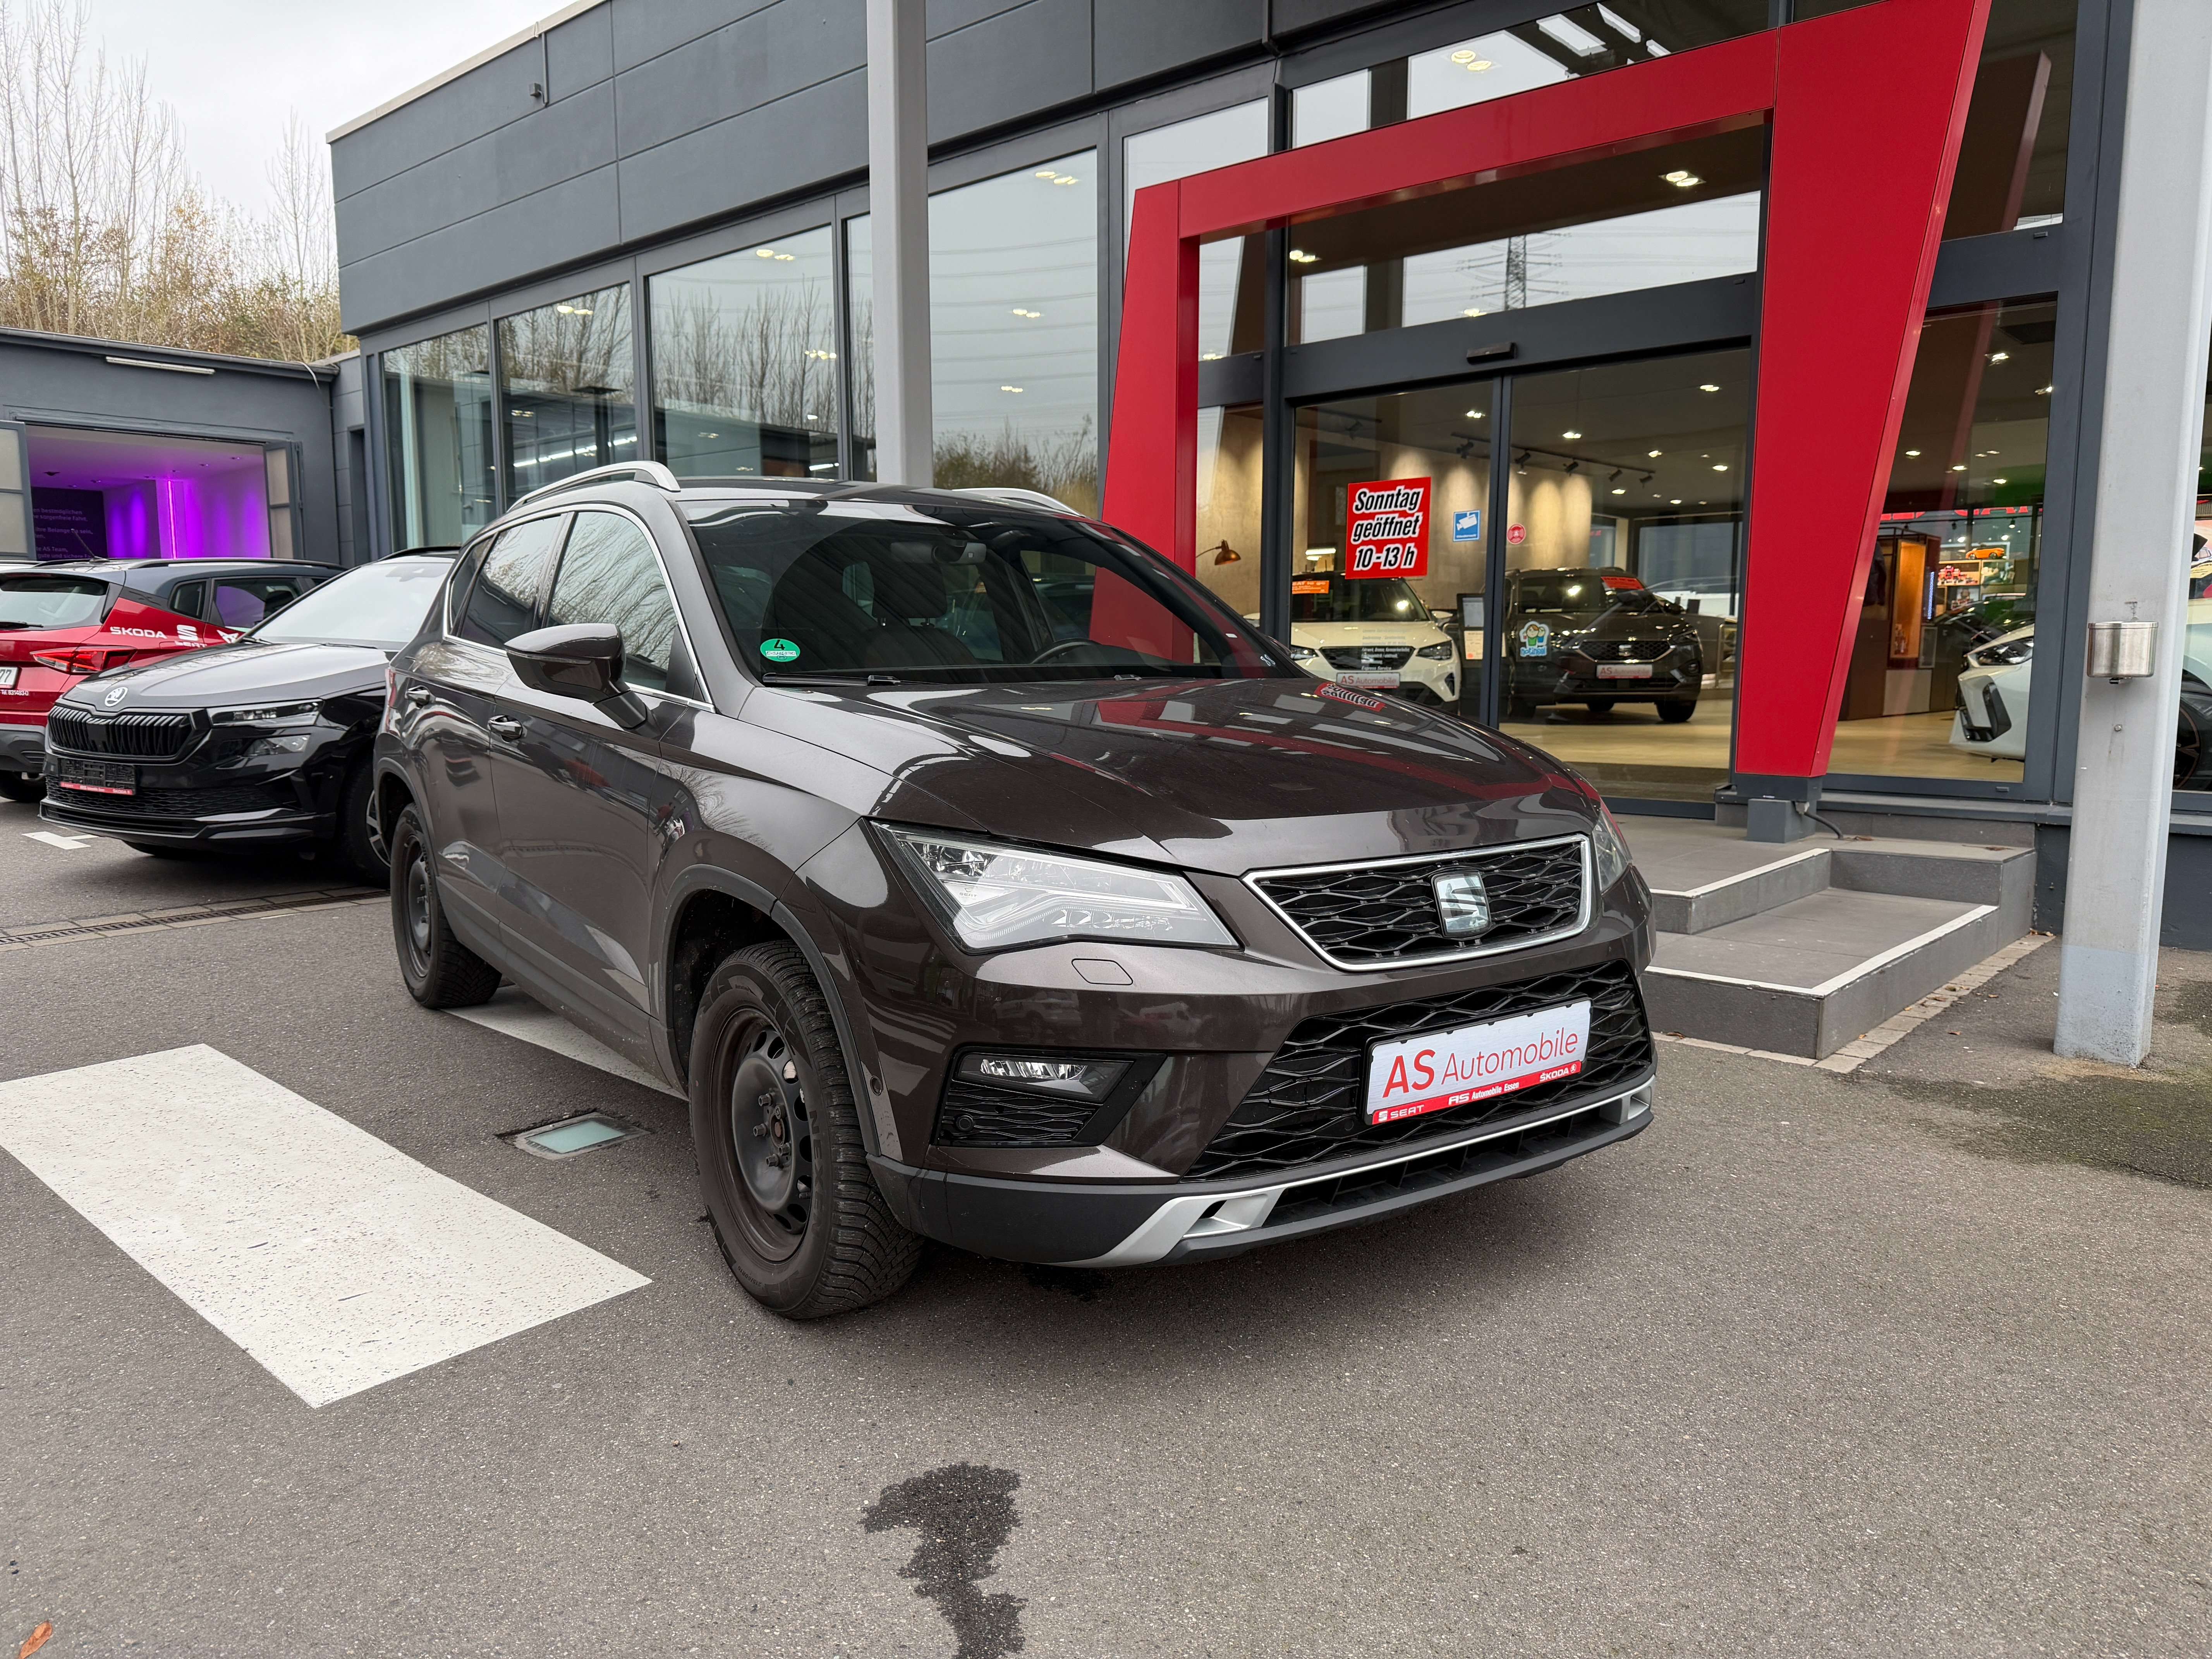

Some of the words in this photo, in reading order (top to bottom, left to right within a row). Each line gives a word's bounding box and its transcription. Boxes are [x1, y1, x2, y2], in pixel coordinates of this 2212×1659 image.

[1354, 487, 1422, 512] Sonntag
[1352, 513, 1422, 543] geöffnet
[1355, 545, 1401, 569] 10-13
[1402, 544, 1417, 567] h
[774, 639, 785, 651] 4
[1340, 675, 1354, 684] AS
[1382, 1049, 1436, 1098] AS
[1441, 1027, 1578, 1085] Automobile
[1448, 1092, 1470, 1105] AS
[1472, 1085, 1502, 1100] Automobile
[1504, 1081, 1520, 1092] Essen
[1390, 1104, 1424, 1119] SEAT
